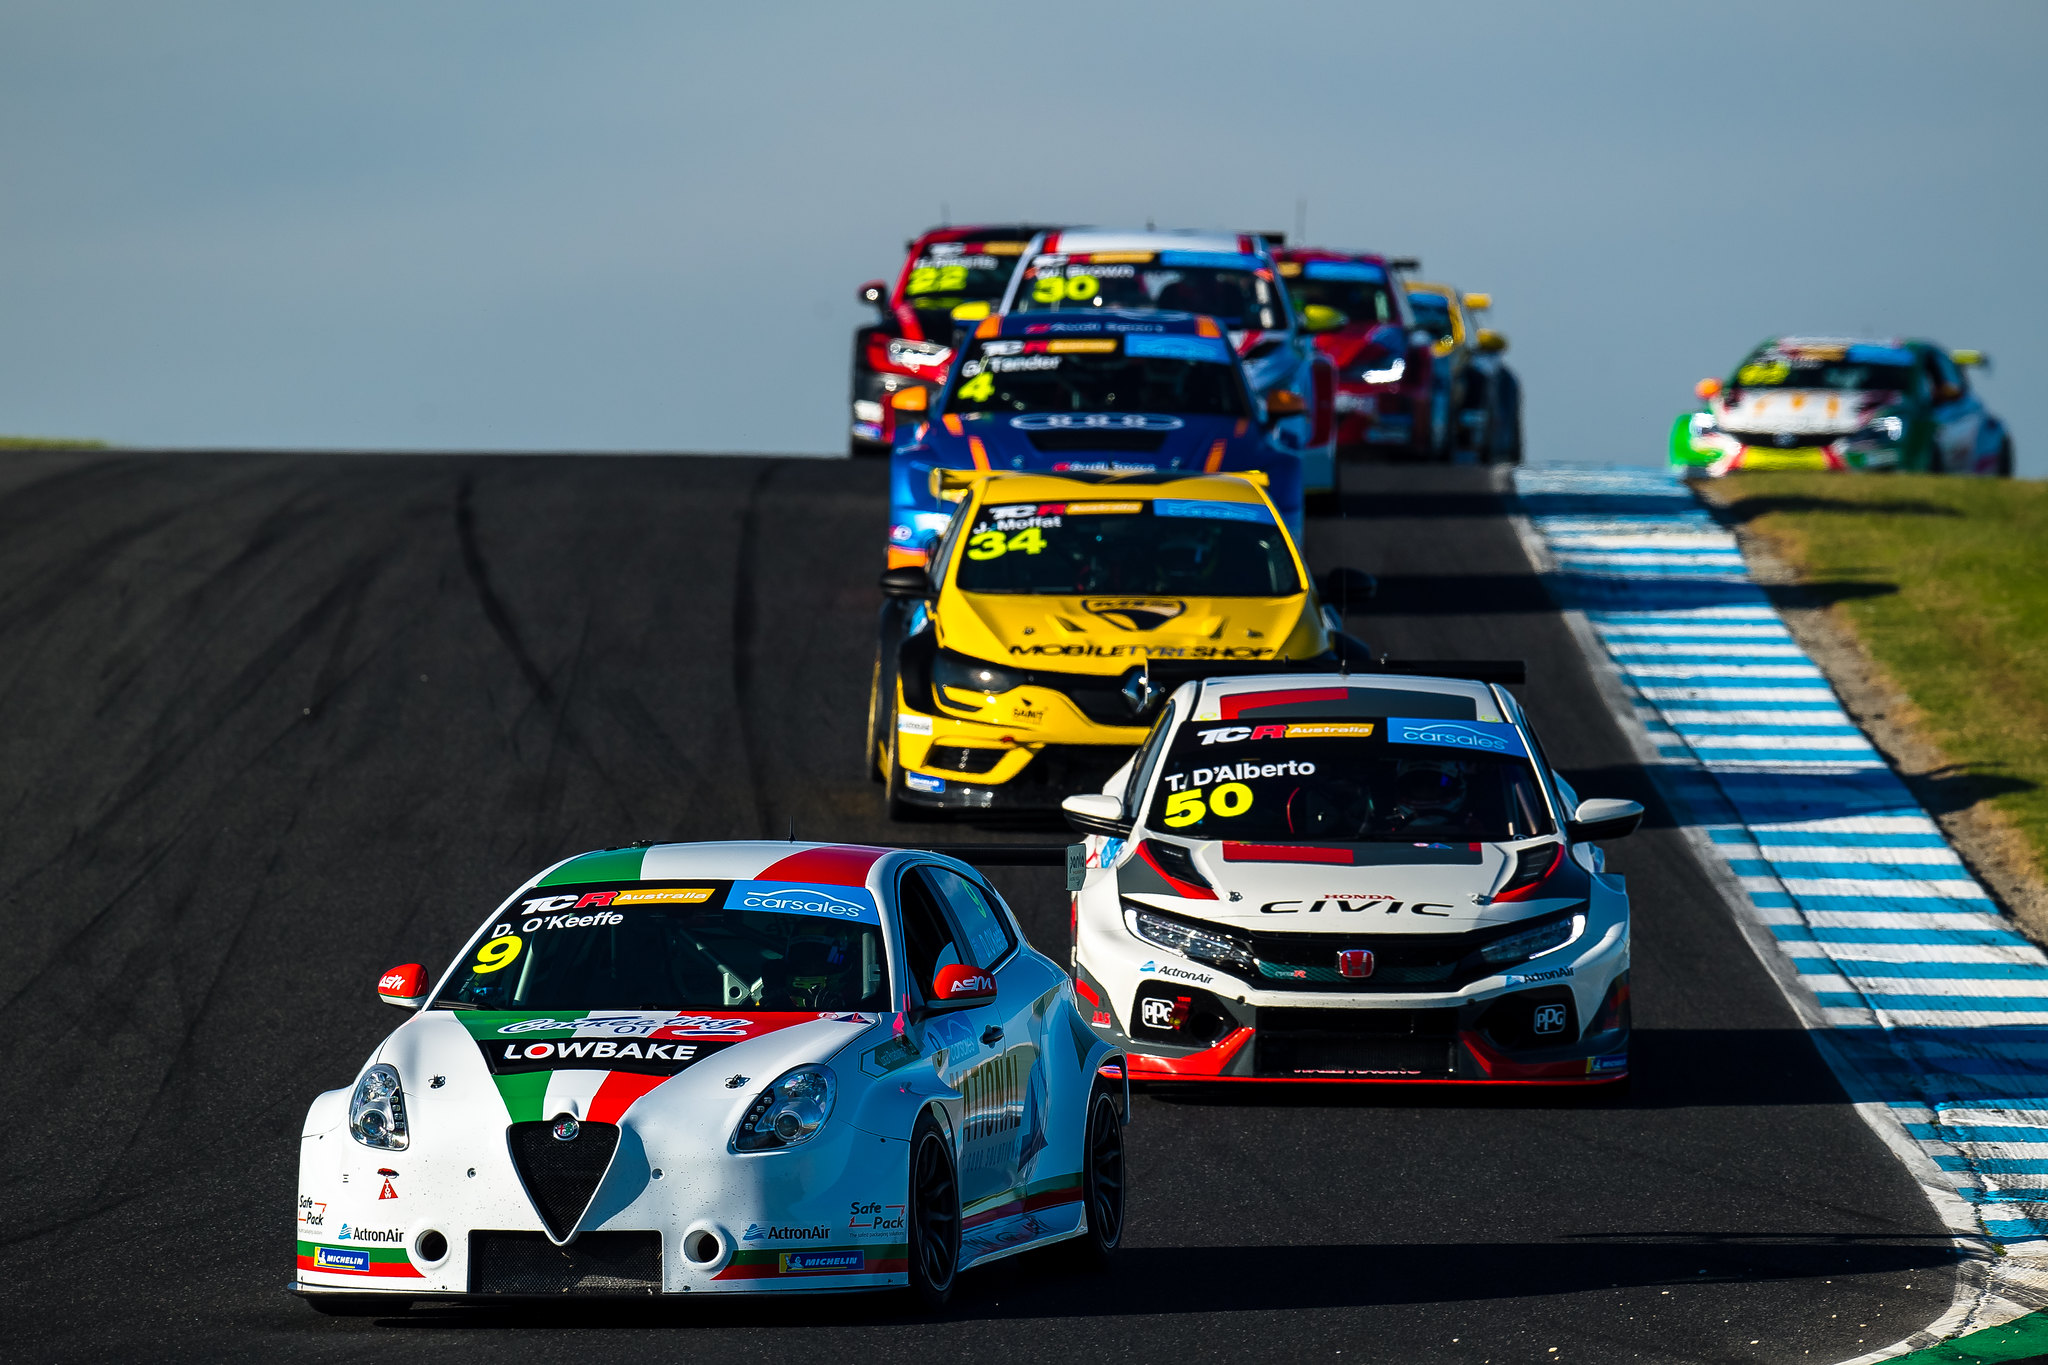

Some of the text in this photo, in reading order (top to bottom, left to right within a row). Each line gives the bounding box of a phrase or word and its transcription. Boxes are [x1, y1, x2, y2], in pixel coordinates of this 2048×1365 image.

[907, 265, 968, 295] 22
[957, 371, 995, 402] 4
[989, 503, 1067, 520] TCR
[996, 516, 1063, 531] Moffat
[967, 527, 1048, 561] 34
[1197, 725, 1370, 745] TCR Australia
[1403, 731, 1505, 750] carsales
[1165, 773, 1186, 791] T.
[1164, 782, 1254, 828] 50
[521, 891, 708, 915] TCR Australia
[744, 897, 860, 917] carsales
[1260, 901, 1454, 917] CIVIC
[491, 923, 514, 939] D.
[472, 935, 523, 974] 9
[1159, 966, 1214, 984] ActronAir
[1524, 966, 1574, 983] ActronAir
[498, 1015, 754, 1034] Connecting
[1537, 1008, 1563, 1030] PPG
[504, 1042, 698, 1061] LOWBAKE
[384, 1182, 392, 1199] TOW
[299, 1195, 313, 1209] Safe
[850, 1201, 882, 1215] Safe
[306, 1211, 323, 1226] Pack
[873, 1216, 905, 1229] Pack
[353, 1227, 404, 1242] ActronAir
[767, 1224, 830, 1241] ActronAir
[326, 1254, 364, 1265] MICHELIN
[805, 1256, 857, 1267] MICHELIN
